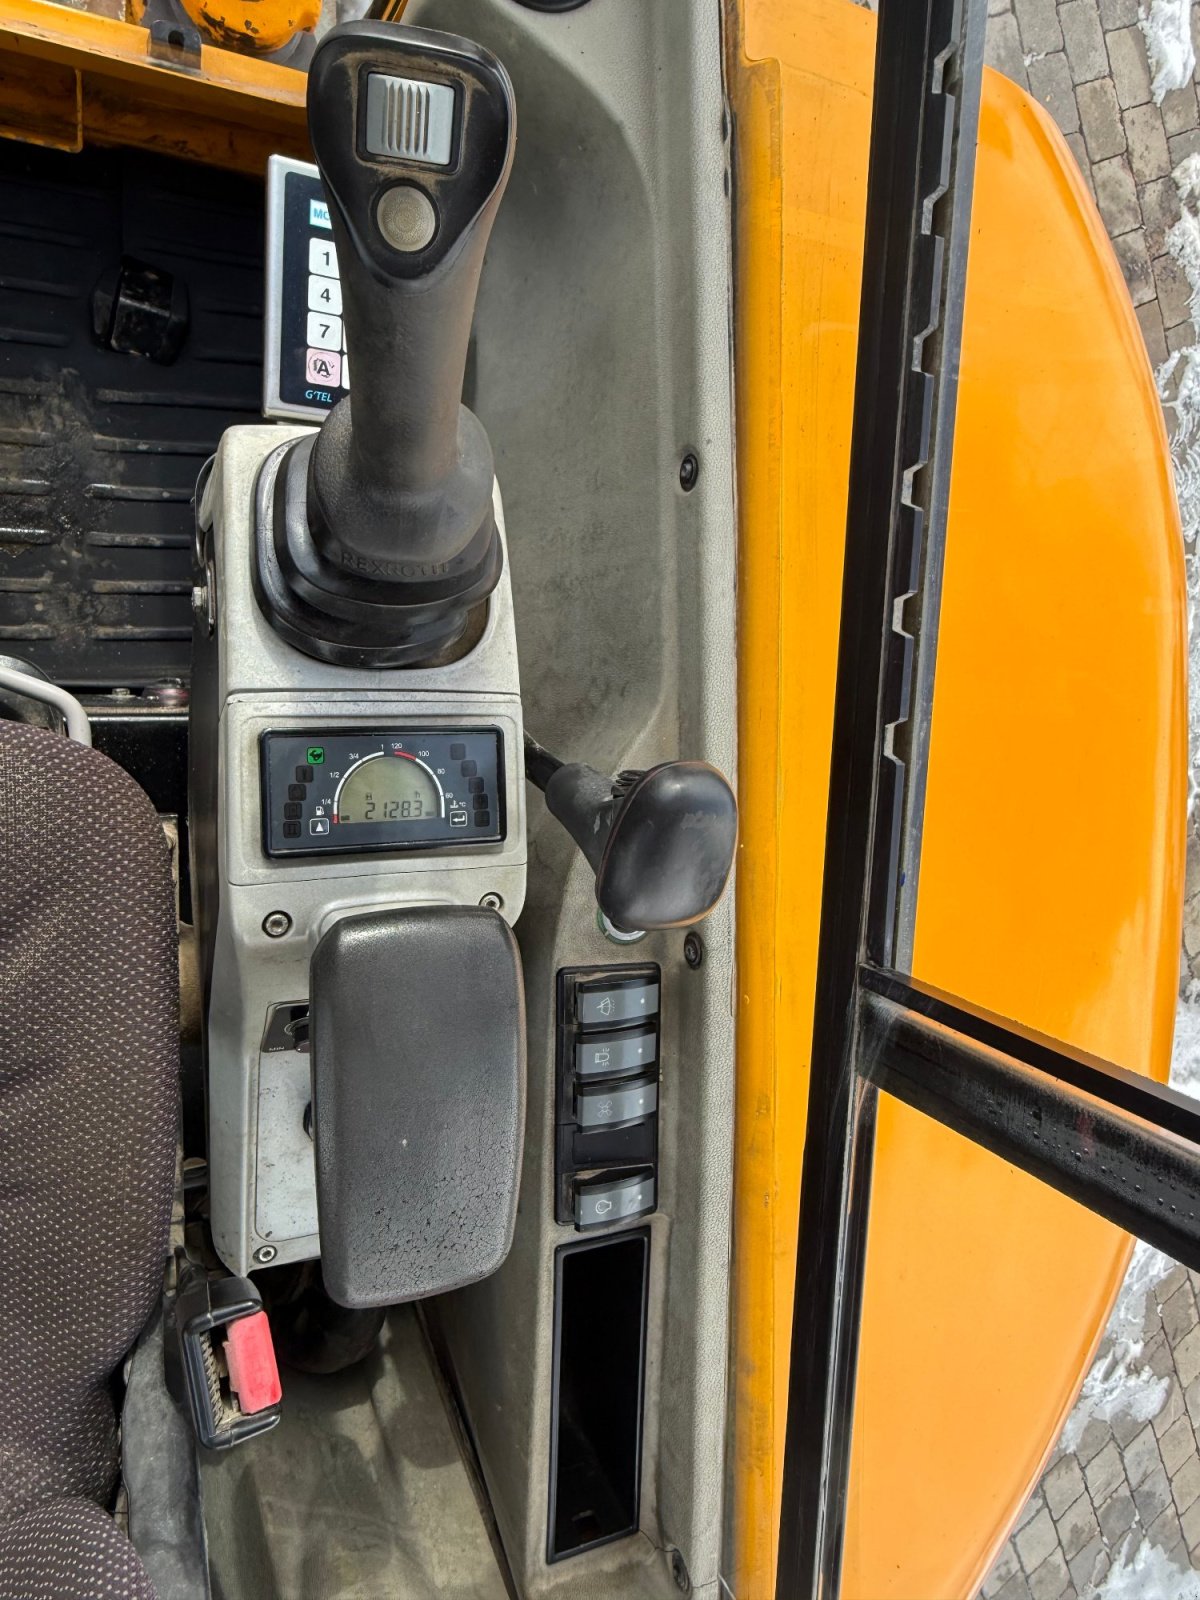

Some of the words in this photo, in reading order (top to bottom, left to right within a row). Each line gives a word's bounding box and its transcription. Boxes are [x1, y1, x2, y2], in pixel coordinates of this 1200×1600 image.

[322, 251, 330, 267] 1
[320, 287, 331, 303] 4
[319, 323, 331, 339] 7
